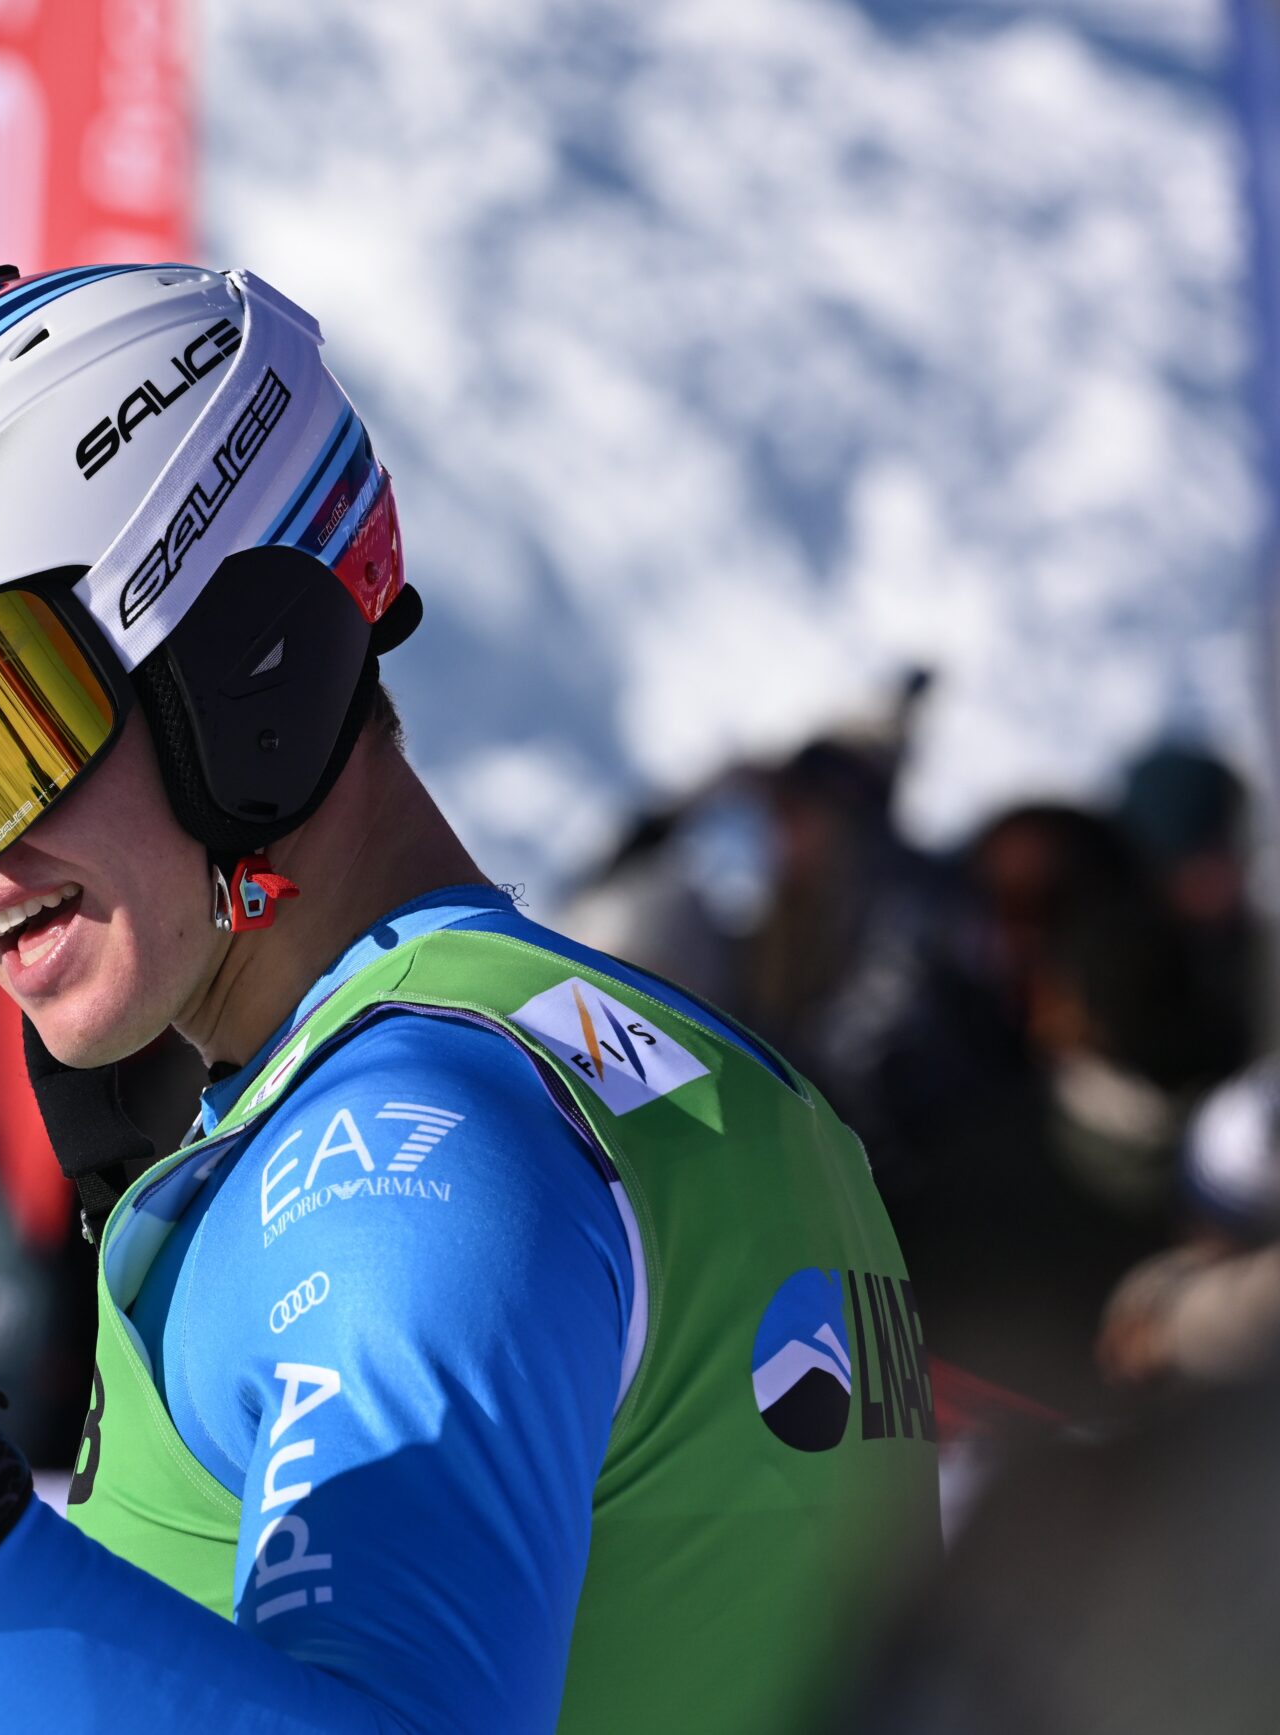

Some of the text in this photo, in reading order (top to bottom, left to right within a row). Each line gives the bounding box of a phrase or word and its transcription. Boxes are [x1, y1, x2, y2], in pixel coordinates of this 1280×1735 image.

[76, 318, 243, 481] SALICE
[119, 366, 292, 630] SALICE
[571, 1022, 657, 1079] FIS
[260, 1101, 467, 1227] EA7
[262, 1176, 452, 1249] EMPORIO ARMANI
[255, 1362, 342, 1624] Audi
